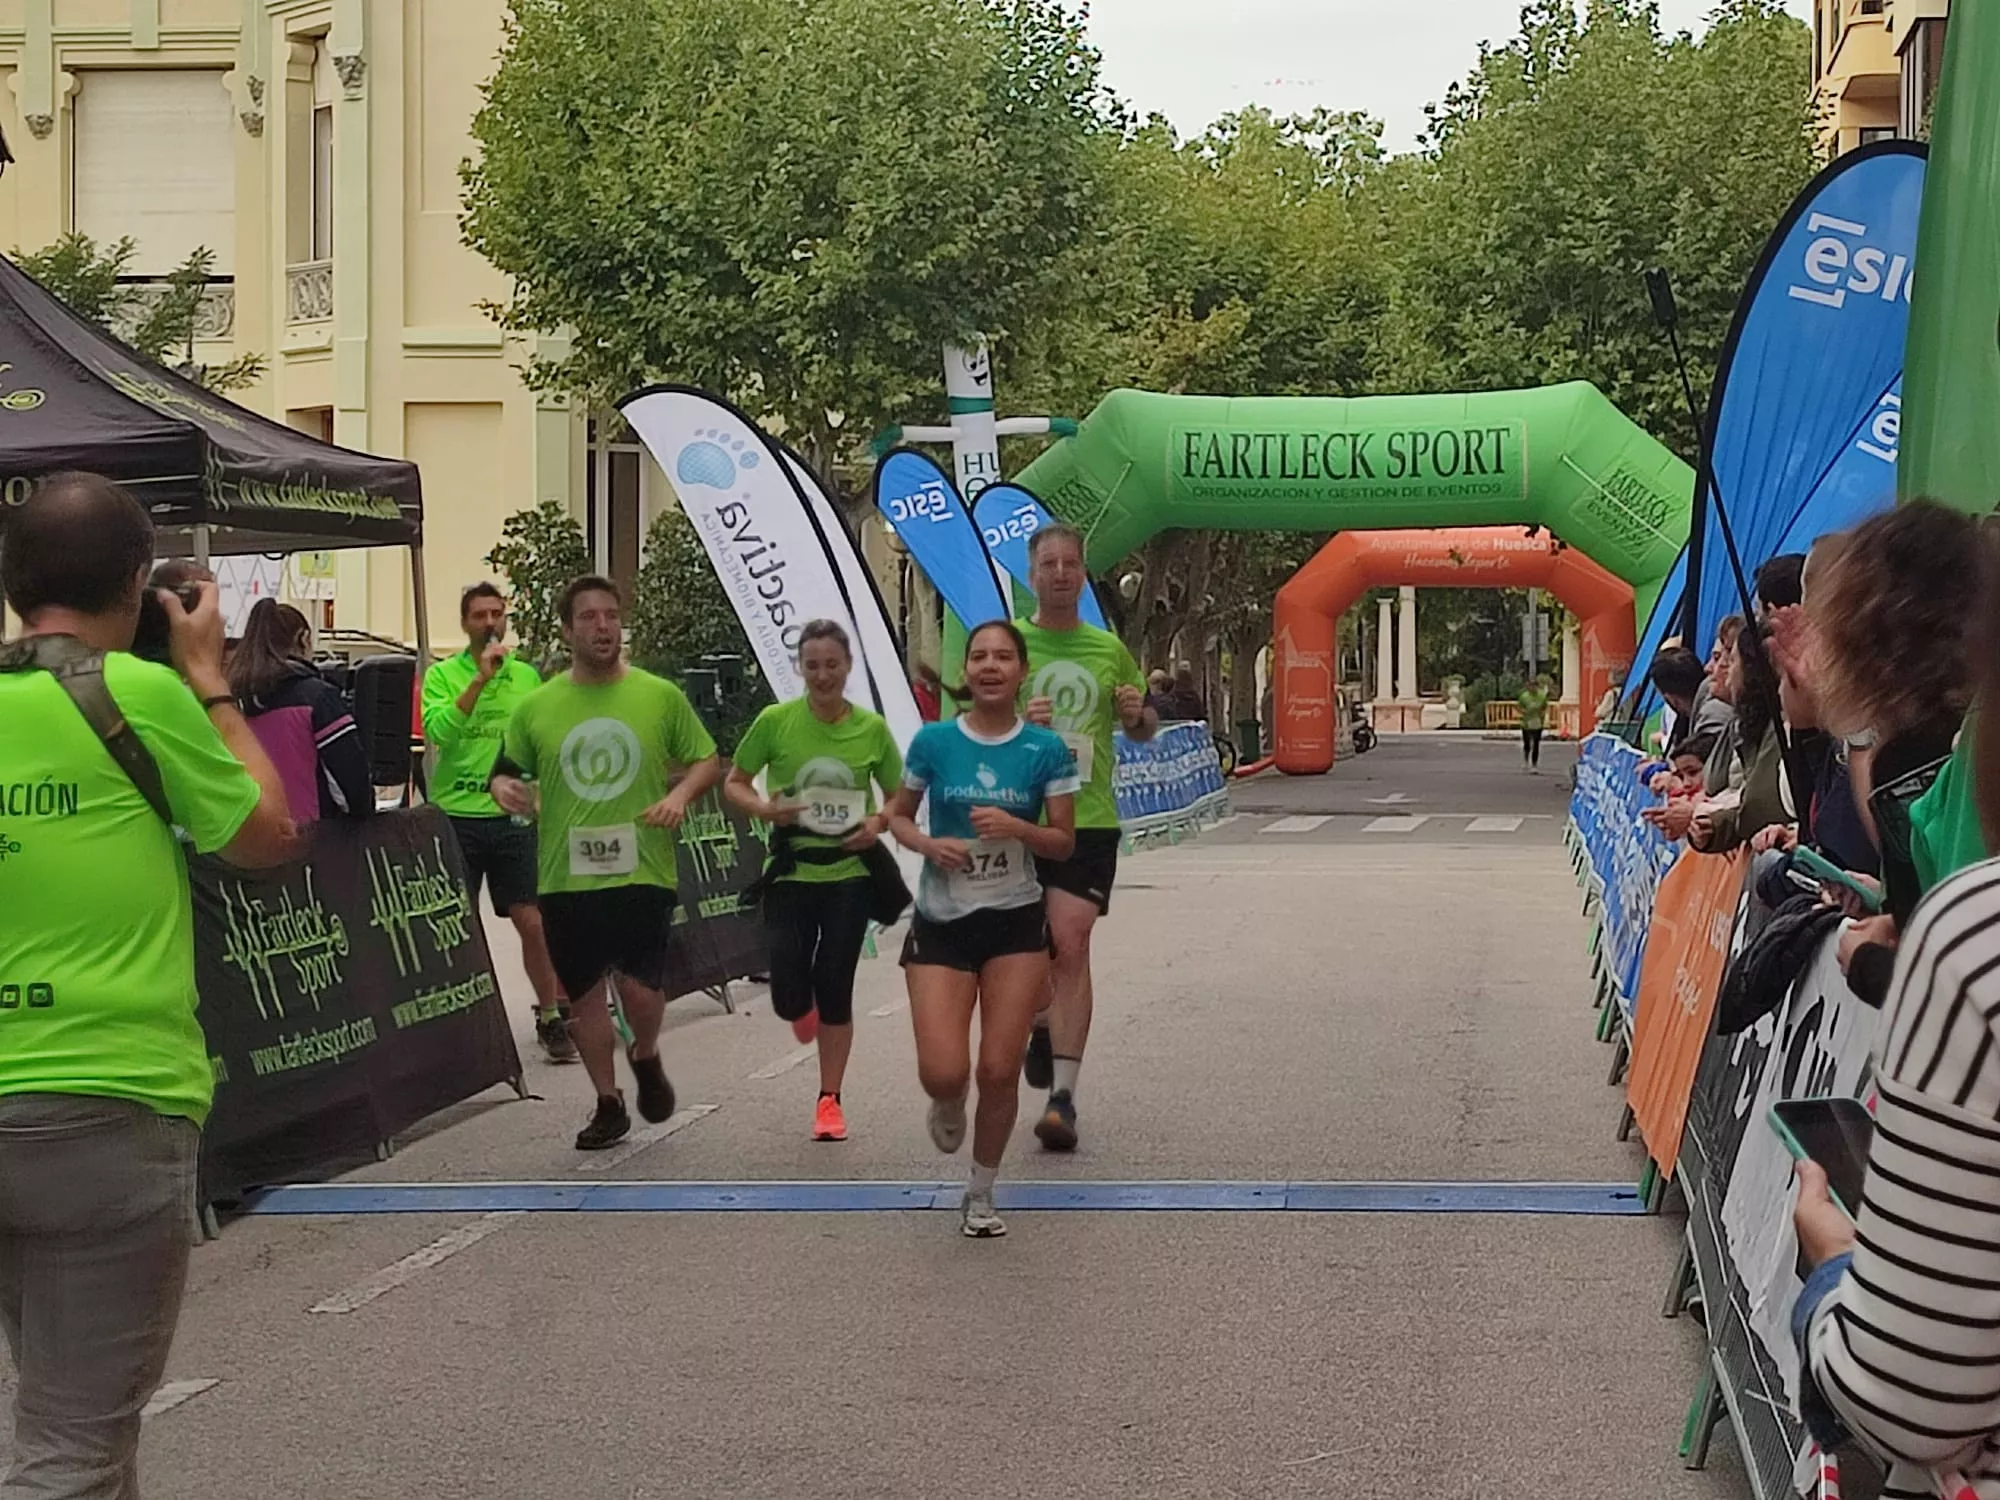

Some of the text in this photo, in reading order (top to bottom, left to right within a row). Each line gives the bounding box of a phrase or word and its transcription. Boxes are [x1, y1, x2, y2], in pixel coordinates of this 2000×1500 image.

[1183, 427, 1511, 481] FARTLECK SPORT
[1315, 486, 1325, 498] Y
[1402, 486, 1424, 498] DE
[1427, 483, 1502, 497] EVENTOS
[1474, 538, 1489, 550] de
[1493, 538, 1547, 550] Huesca
[811, 801, 850, 819] 395
[580, 838, 622, 856] 394
[289, 950, 343, 1012] Sport
